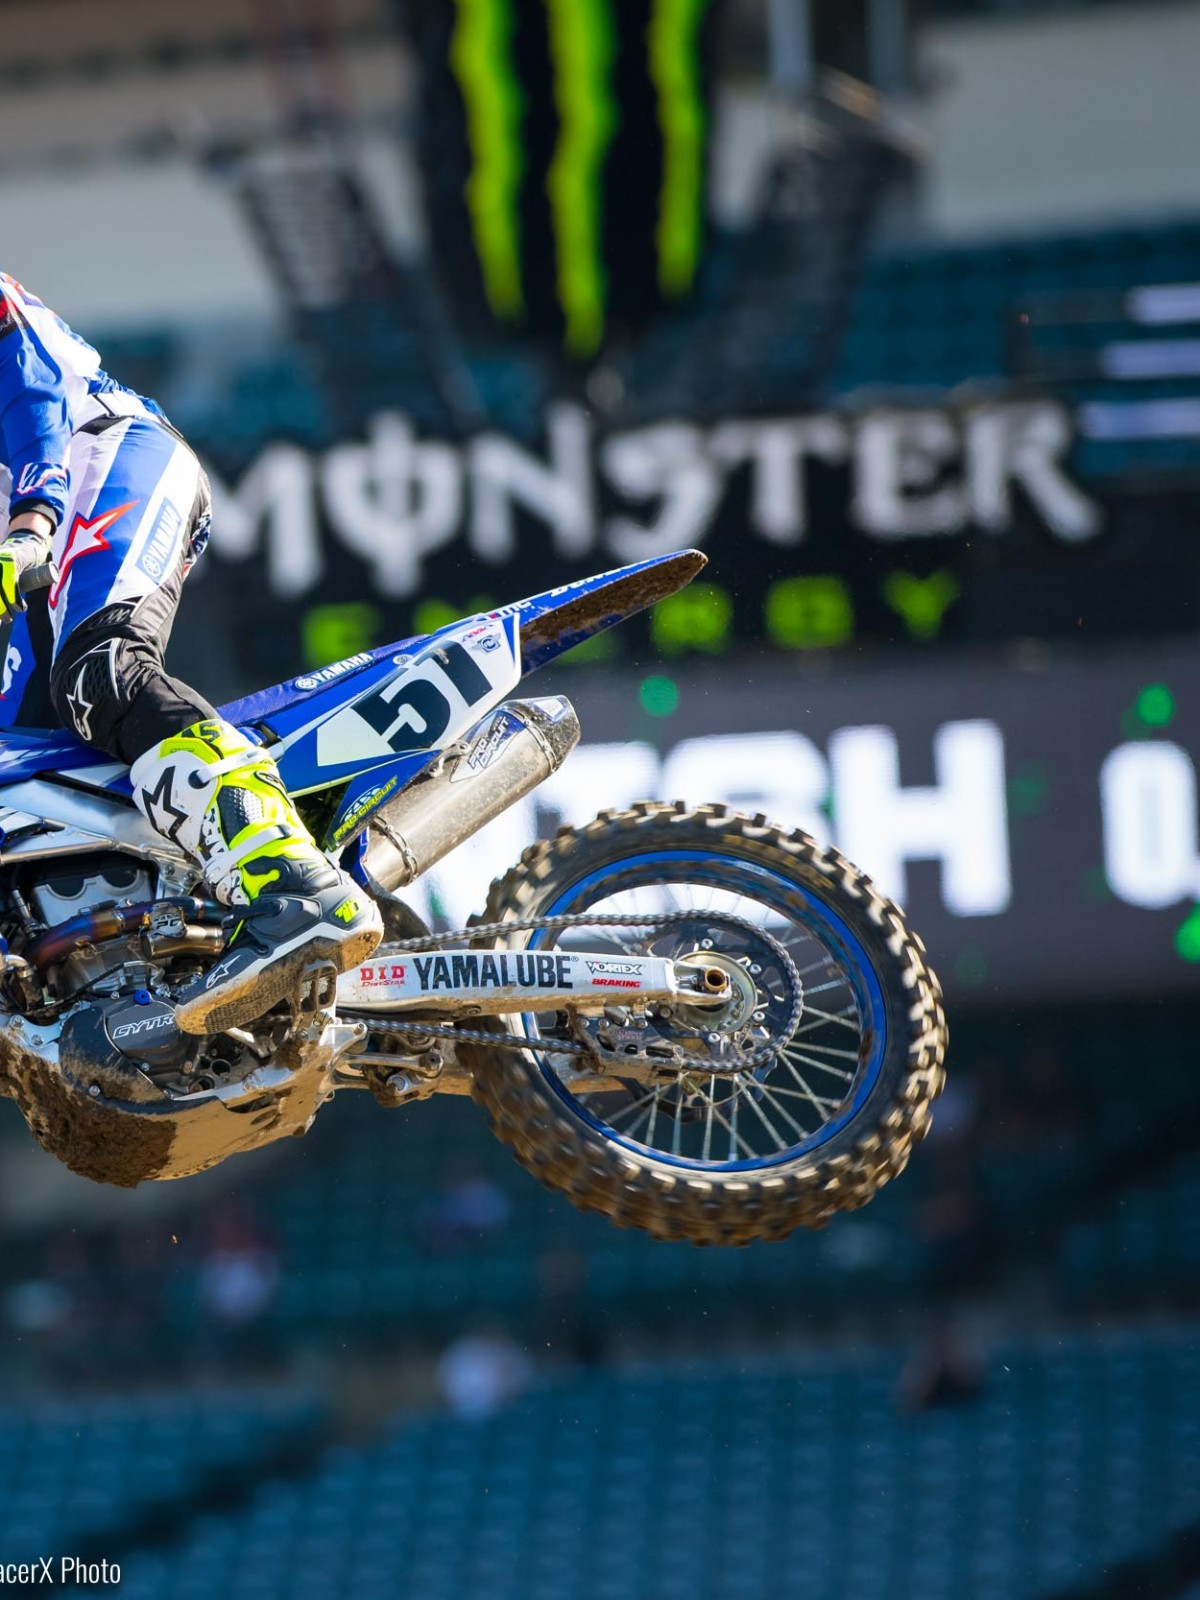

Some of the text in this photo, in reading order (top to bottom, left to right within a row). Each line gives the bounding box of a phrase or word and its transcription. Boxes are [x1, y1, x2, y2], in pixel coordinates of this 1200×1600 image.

[205, 400, 1102, 598] MONSTER
[311, 652, 374, 682] YAMAHA
[350, 641, 493, 753] 51
[467, 736, 490, 770] PRO
[478, 716, 509, 769] CIRCUIT
[333, 775, 399, 841] PRO CIRCUIT
[413, 954, 573, 990] YAMALUBE
[585, 960, 643, 976] VORTEX
[591, 977, 641, 989] BRAKING
[112, 1012, 177, 1040] GYTR
